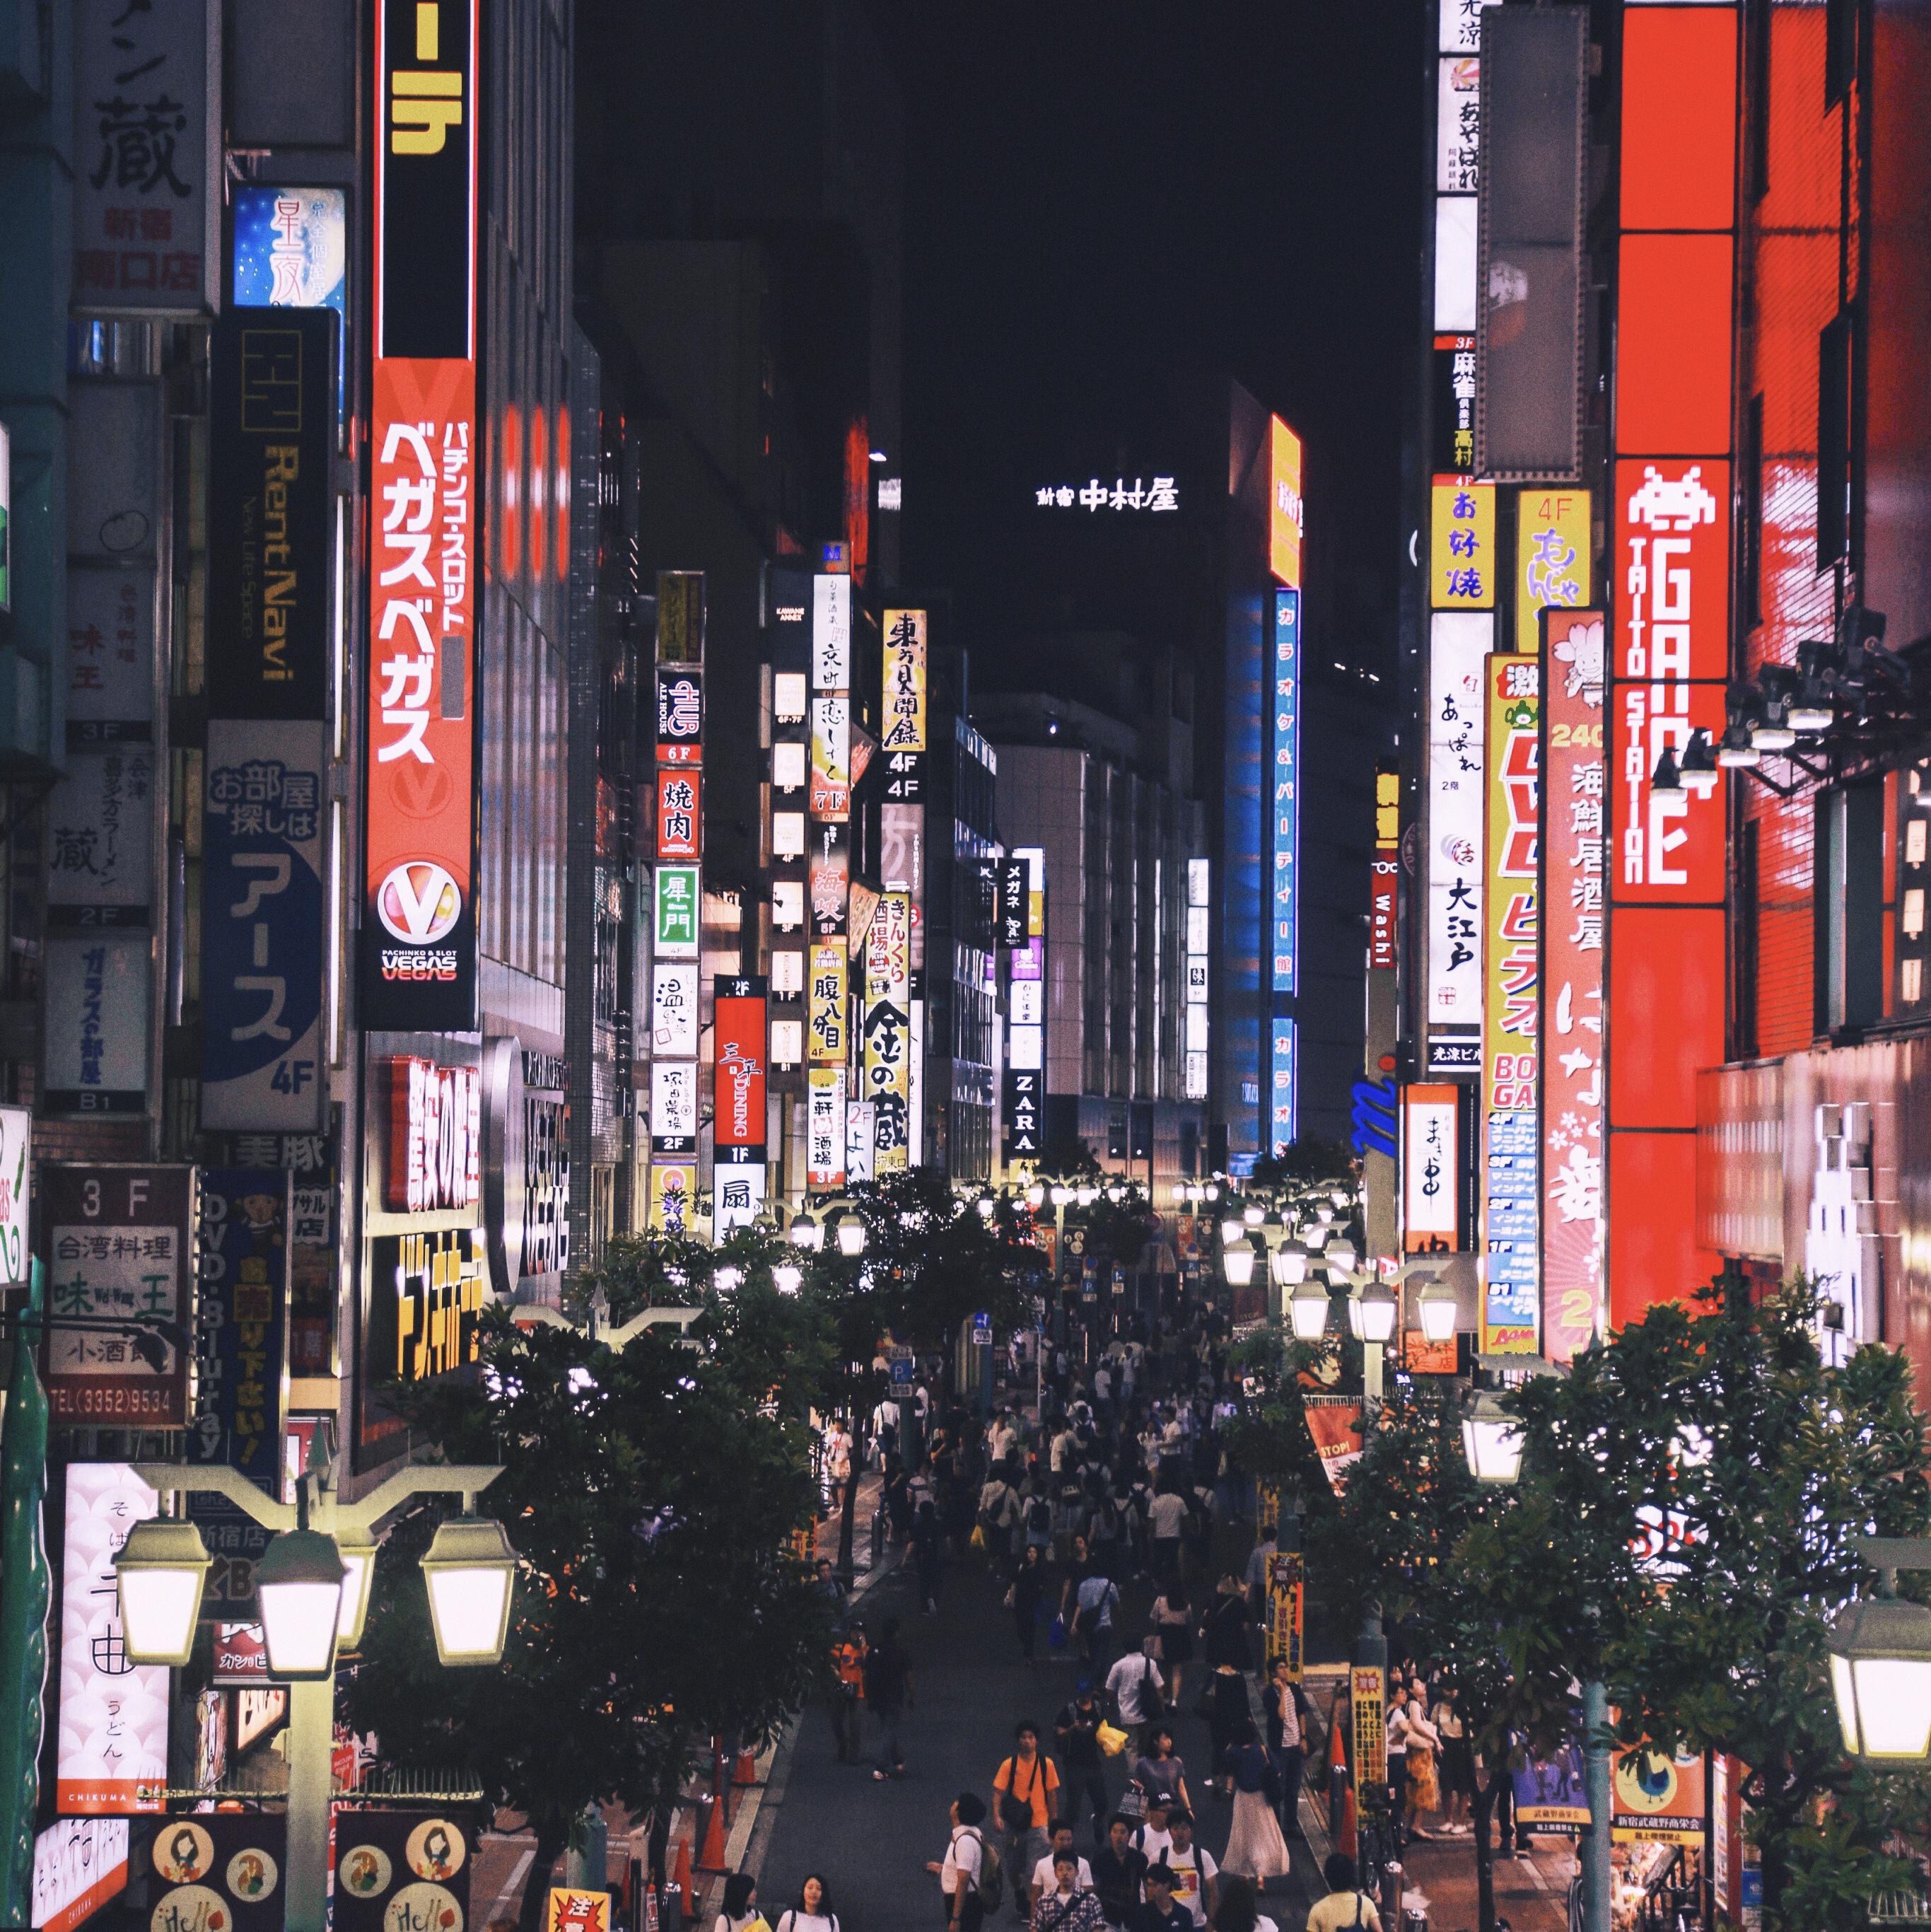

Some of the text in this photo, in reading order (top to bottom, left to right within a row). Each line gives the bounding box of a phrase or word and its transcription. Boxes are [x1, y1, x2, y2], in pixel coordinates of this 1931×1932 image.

[90, 95, 191, 198] 蔵
[104, 208, 173, 240] 新宿
[274, 201, 301, 303] 星夜
[76, 250, 201, 291] 南口店
[1454, 337, 1476, 349] 3F
[441, 422, 469, 631] パチンコ・スロット
[1538, 498, 1573, 521] 4F
[1446, 491, 1483, 598] お好焼
[263, 446, 299, 681] RentNavi
[378, 422, 438, 764] ベガスベガス
[1628, 537, 1646, 676] TAITO
[659, 682, 667, 705] ALE
[884, 612, 921, 747] 東方見聞録
[667, 680, 700, 736] HUB
[83, 723, 120, 740] 3F
[1441, 693, 1481, 772] あっぱれ
[667, 747, 691, 760] 6F
[889, 752, 917, 772] 4F
[212, 763, 315, 810] お部屋
[815, 791, 846, 810] 7F
[887, 780, 918, 796] 4F
[1624, 690, 1645, 884] STATION
[230, 807, 313, 839] 探しは
[663, 780, 694, 842] 焼肉
[51, 827, 98, 875] 蔵
[782, 854, 793, 863] 4F
[1007, 866, 1020, 909] メガネ
[80, 908, 119, 925] 2F
[781, 924, 794, 933] 3F
[820, 923, 836, 933] 5F
[1446, 877, 1478, 972] 大江戸
[231, 853, 292, 1042] アース
[890, 899, 906, 984] きんくら
[383, 956, 457, 970] VEGAS
[813, 974, 844, 1049] 腹八分目
[812, 1048, 824, 1057] 4F
[271, 1061, 314, 1095] 4F
[865, 999, 909, 1151] 金の蔵
[80, 1093, 110, 1110] B1
[734, 1079, 747, 1137] DINING
[849, 1105, 873, 1125] 2F
[1016, 1076, 1035, 1151] ZARA
[663, 1138, 684, 1149] 2F
[731, 1147, 749, 1163] 1F
[816, 1172, 837, 1184] 3F
[57, 1235, 173, 1261] 台湾料理
[53, 1271, 93, 1316] 味
[134, 1274, 174, 1319] 王
[50, 1388, 170, 1413] TEL(3352)9534
[103, 1700, 124, 1759] うどん
[69, 1793, 127, 1802] CHIKUMA
[1618, 1815, 1699, 1831] 新宿武蔵野商栄会
